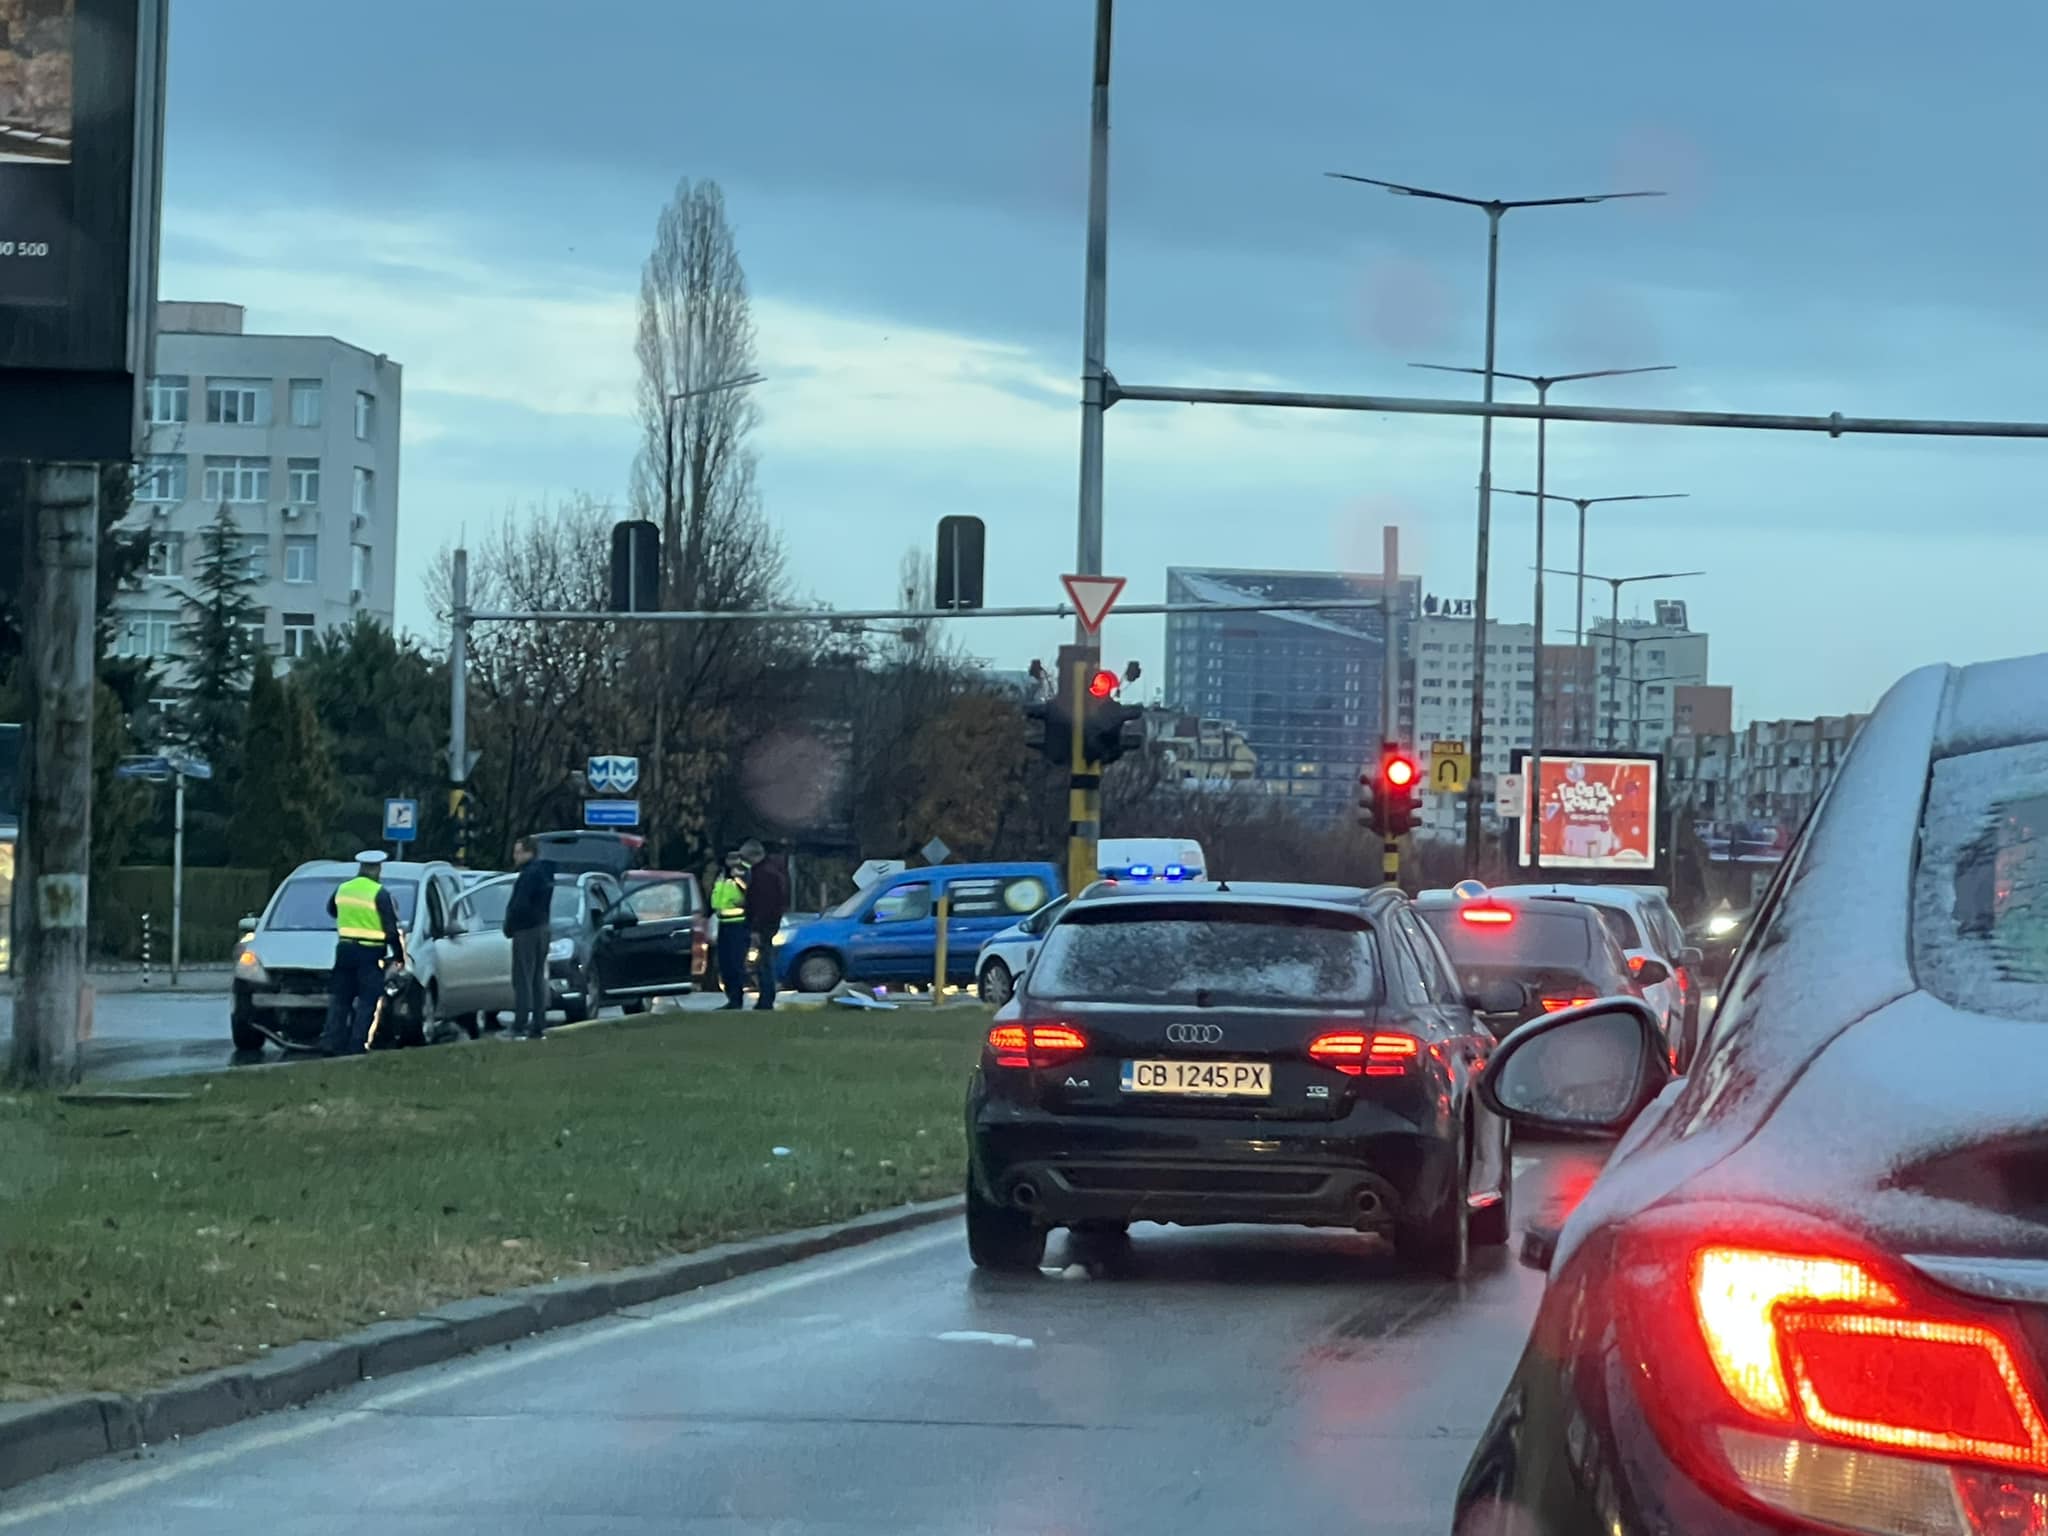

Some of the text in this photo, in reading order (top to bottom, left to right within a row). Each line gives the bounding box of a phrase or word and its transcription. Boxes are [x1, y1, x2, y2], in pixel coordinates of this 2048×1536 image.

[18, 242, 49, 256] 500
[1064, 1076, 1089, 1087] A4
[1137, 1064, 1265, 1089] CB 1245 PX
